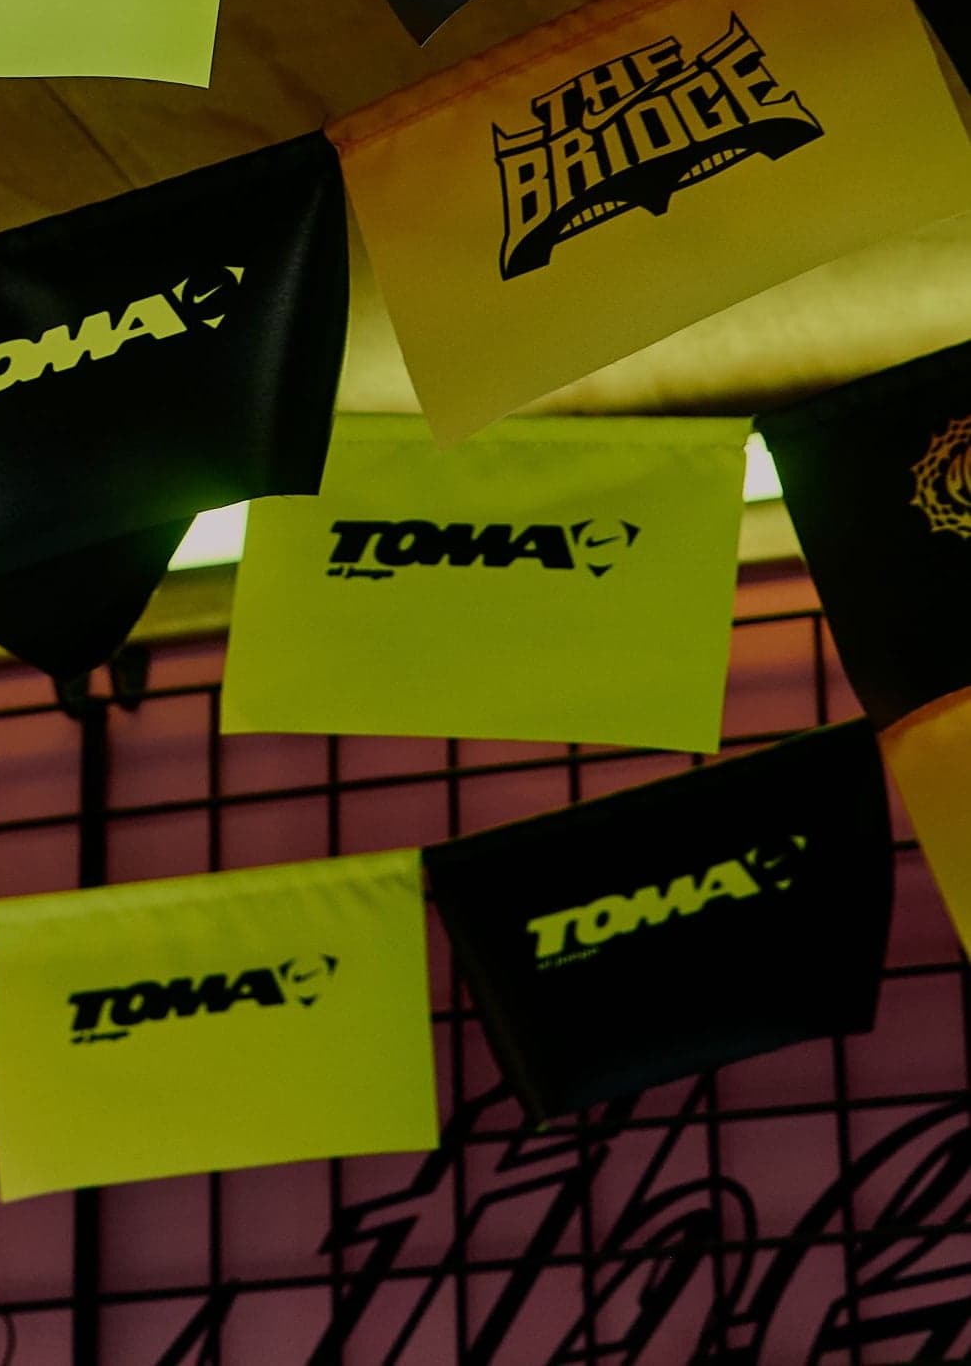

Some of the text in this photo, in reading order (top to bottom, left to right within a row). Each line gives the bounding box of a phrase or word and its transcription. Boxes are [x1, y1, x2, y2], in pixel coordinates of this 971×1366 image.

[531, 35, 684, 136] THE
[492, 10, 825, 281] BRIDGE
[330, 520, 575, 570] TOMA
[526, 858, 761, 958] TOMA
[68, 967, 286, 1032] TOMA
